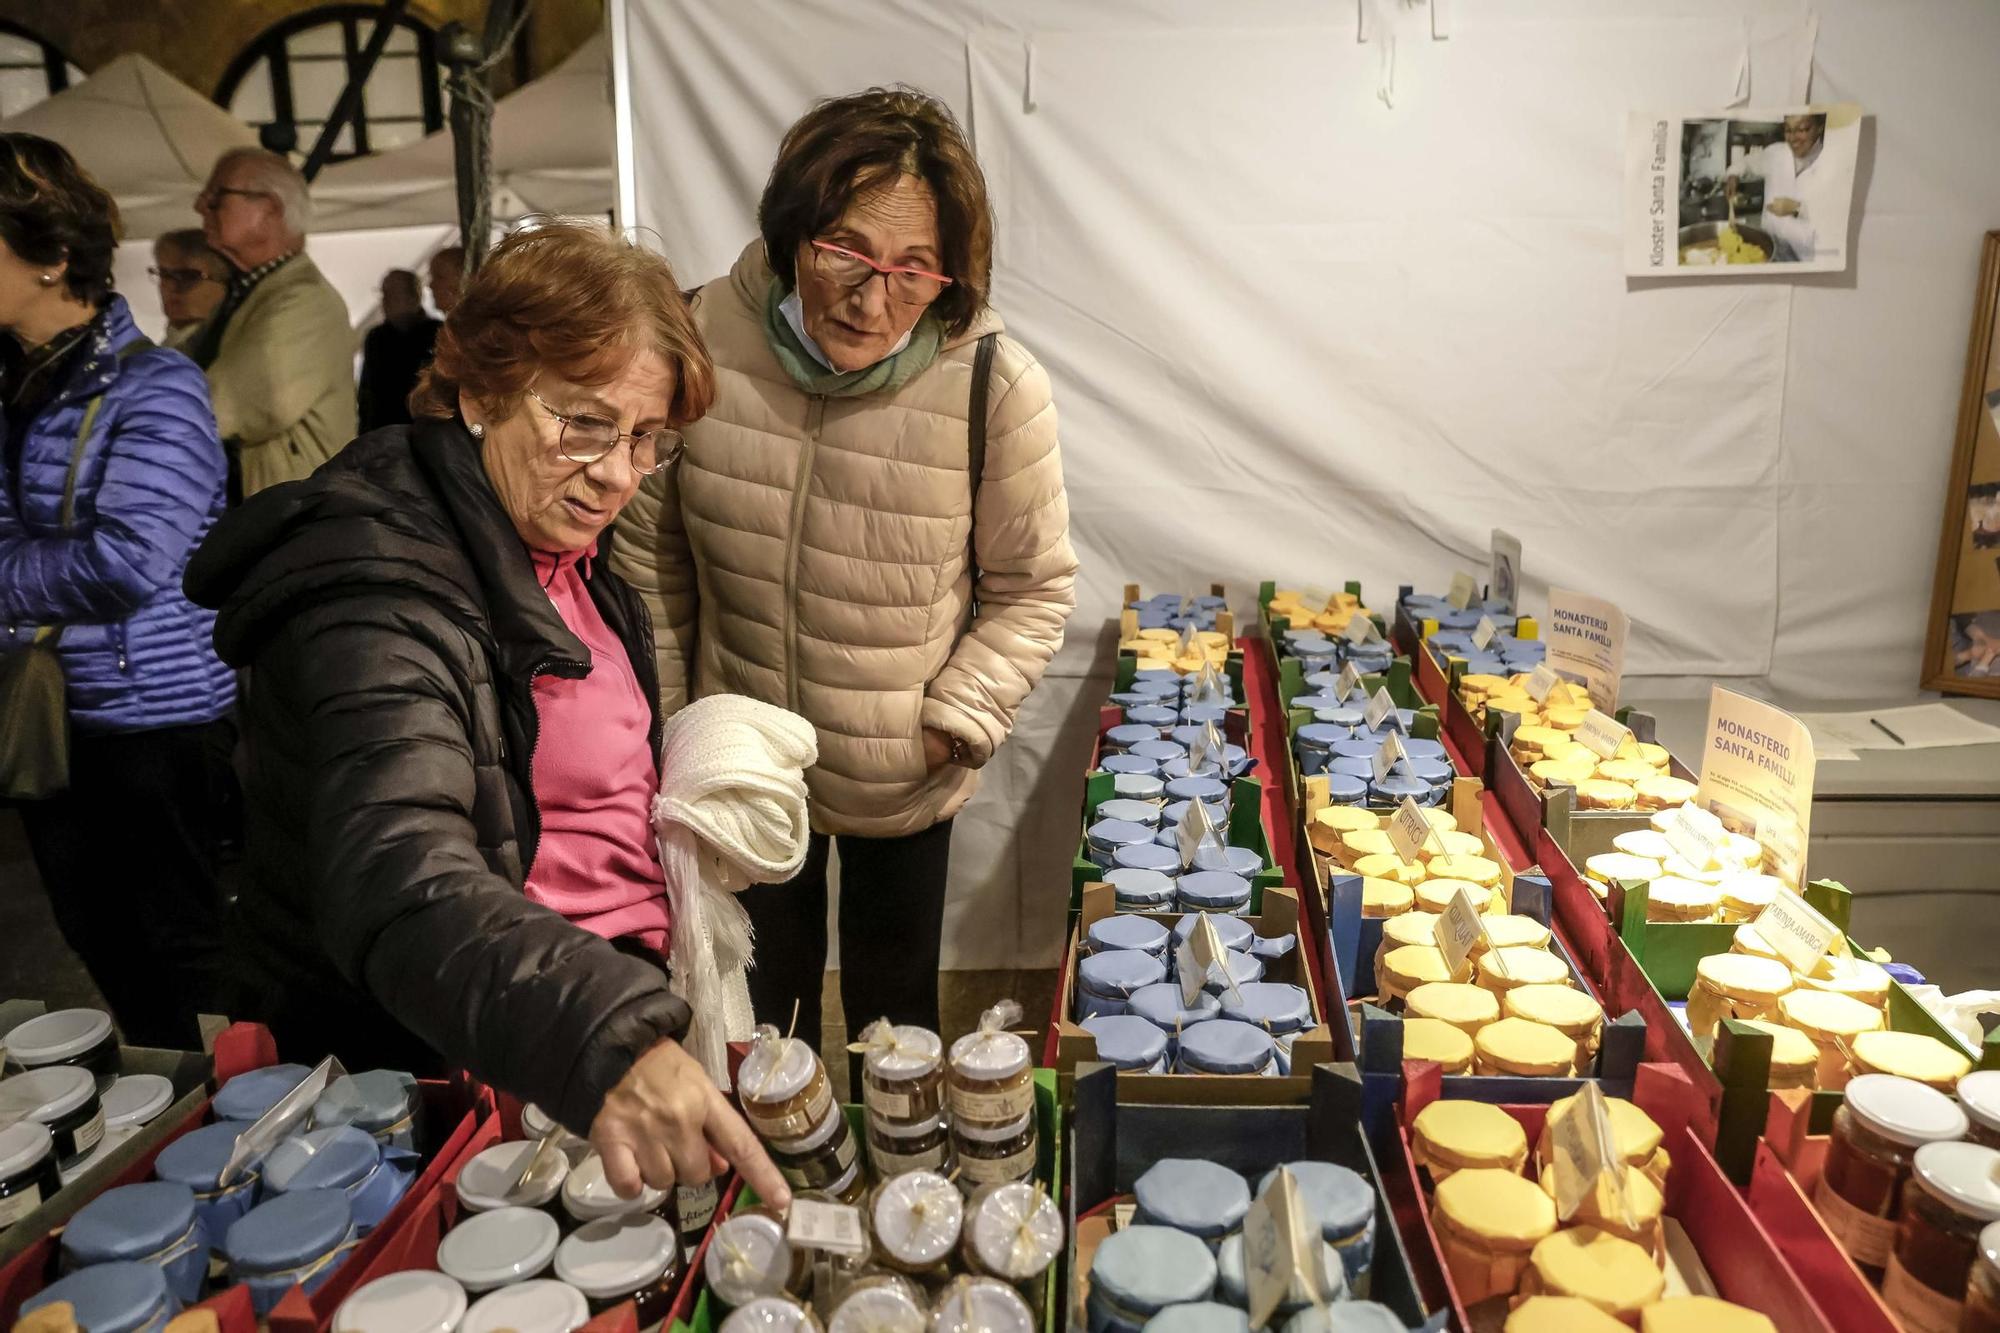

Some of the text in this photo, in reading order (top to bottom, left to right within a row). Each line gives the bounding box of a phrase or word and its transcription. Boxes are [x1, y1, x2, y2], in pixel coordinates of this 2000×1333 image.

[1650, 120, 1668, 267] Kloster Santa Familia
[1553, 609, 1608, 631] MONASTERIO
[1553, 622, 1583, 639] SANTA
[1714, 736, 1754, 763] SANTA
[1717, 717, 1791, 761] MONASTERIO
